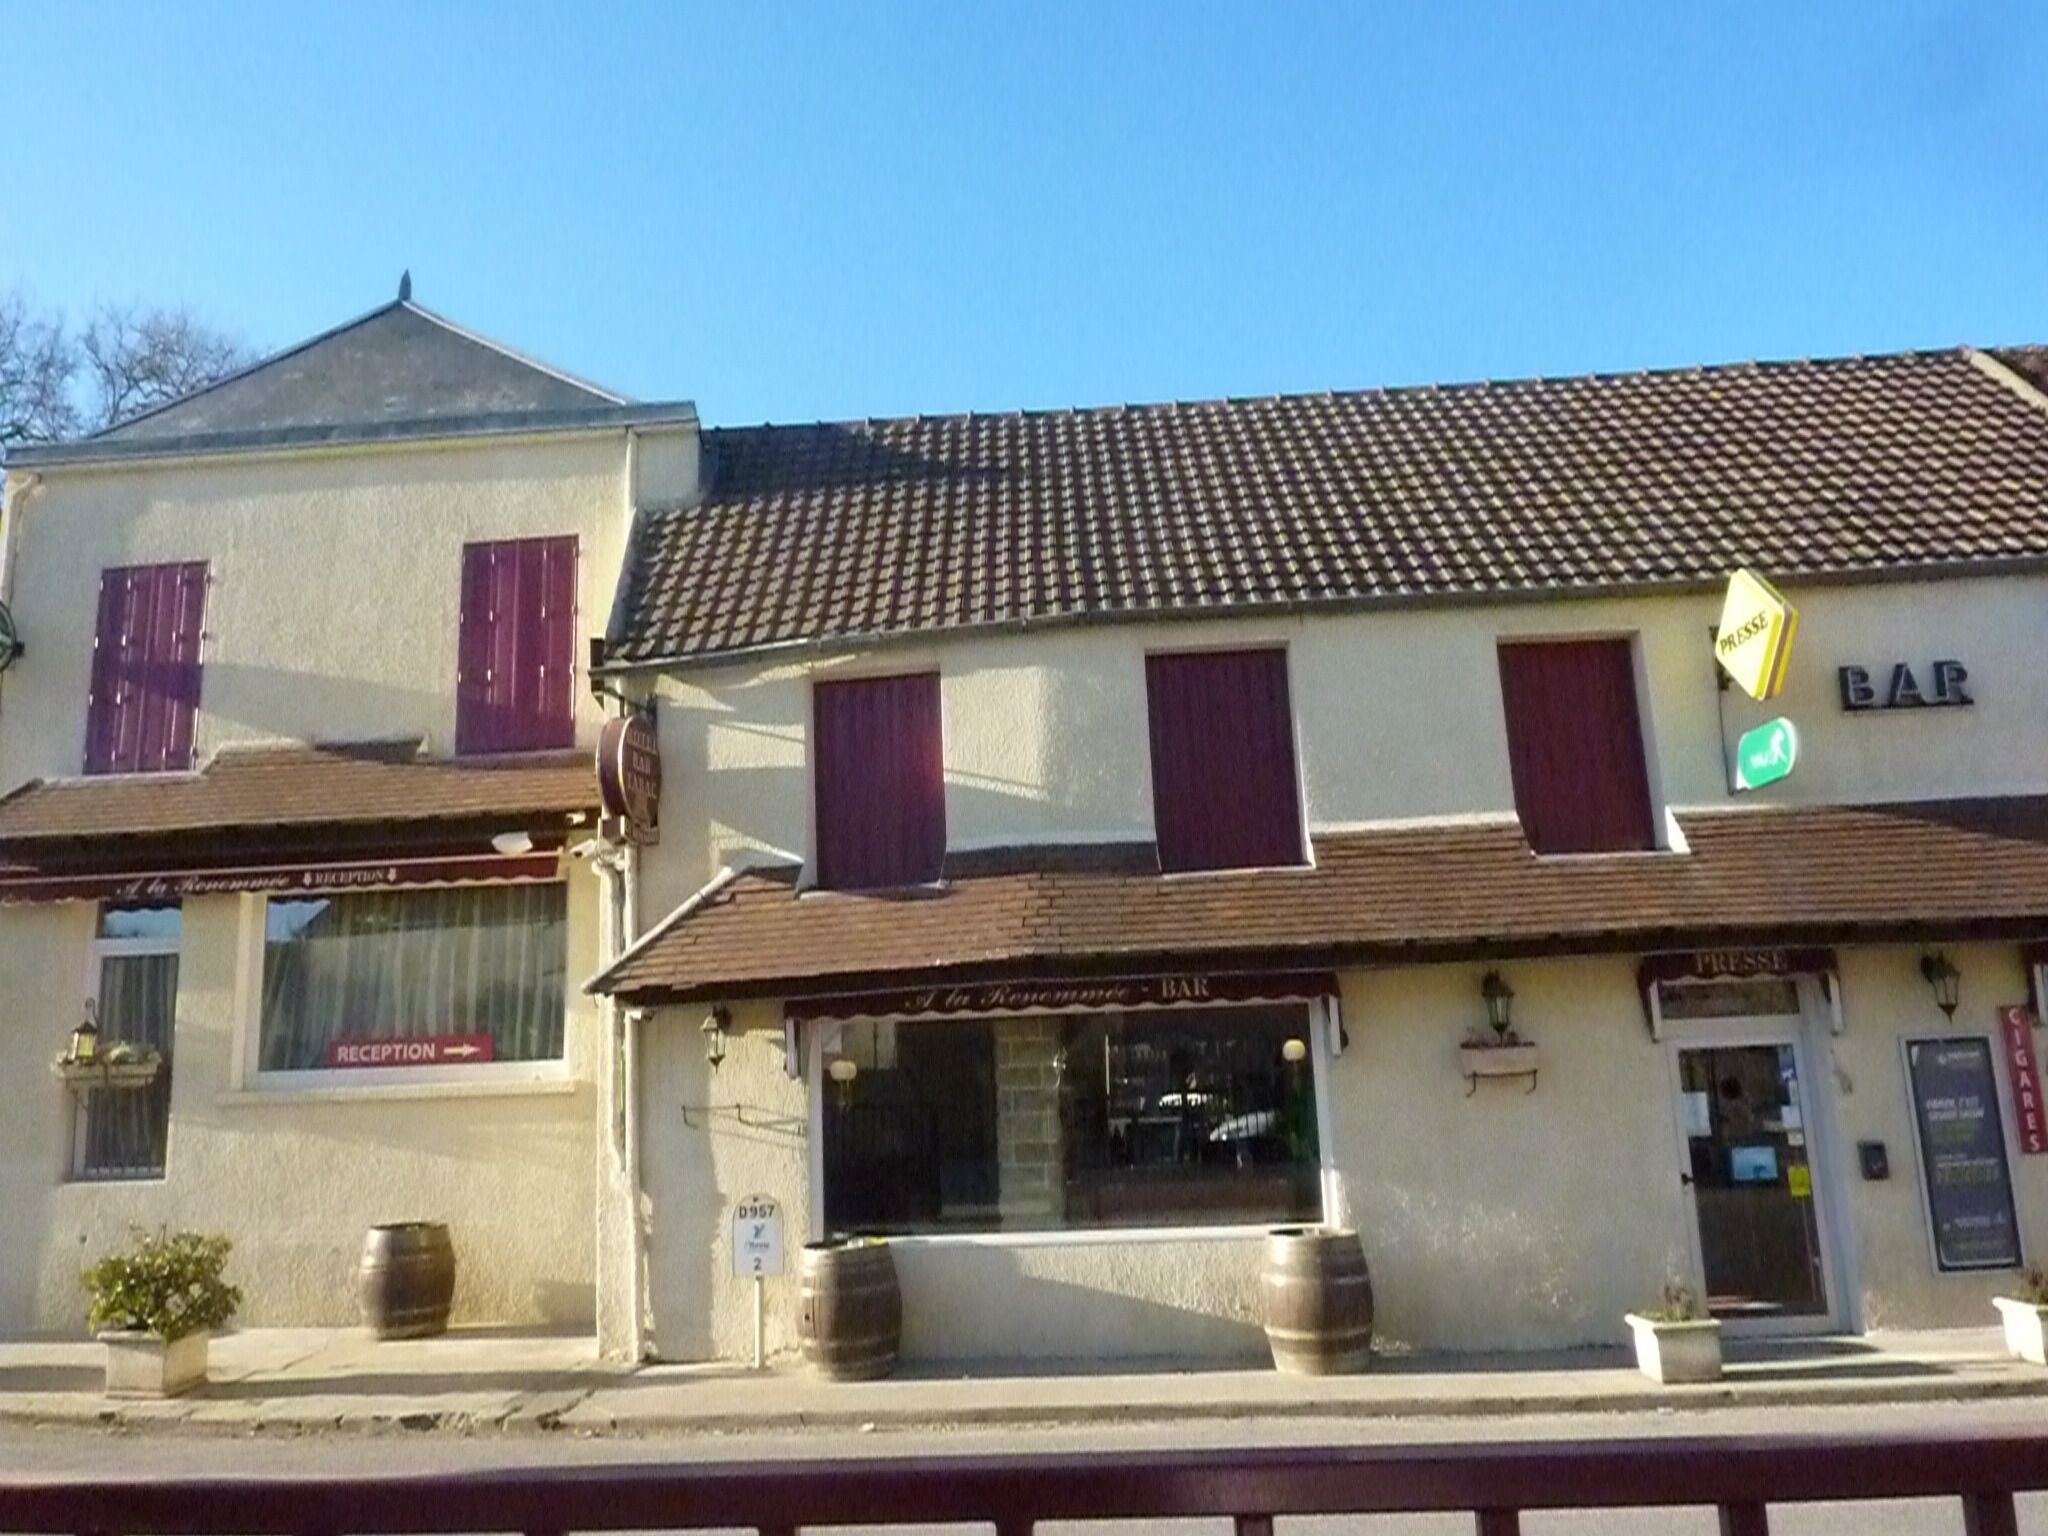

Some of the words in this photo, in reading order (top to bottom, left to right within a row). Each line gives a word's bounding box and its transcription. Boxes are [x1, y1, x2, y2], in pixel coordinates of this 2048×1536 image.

[1720, 611, 1769, 656] PRESSE
[1838, 659, 1974, 710] BAR
[315, 869, 384, 886] RECEPTION
[1695, 949, 1788, 973] PRESSE
[1162, 976, 1210, 999] BAR
[337, 1043, 436, 1063] RECEPTION
[2008, 1007, 2040, 1151] CIGARES
[753, 1256, 762, 1271] 2
